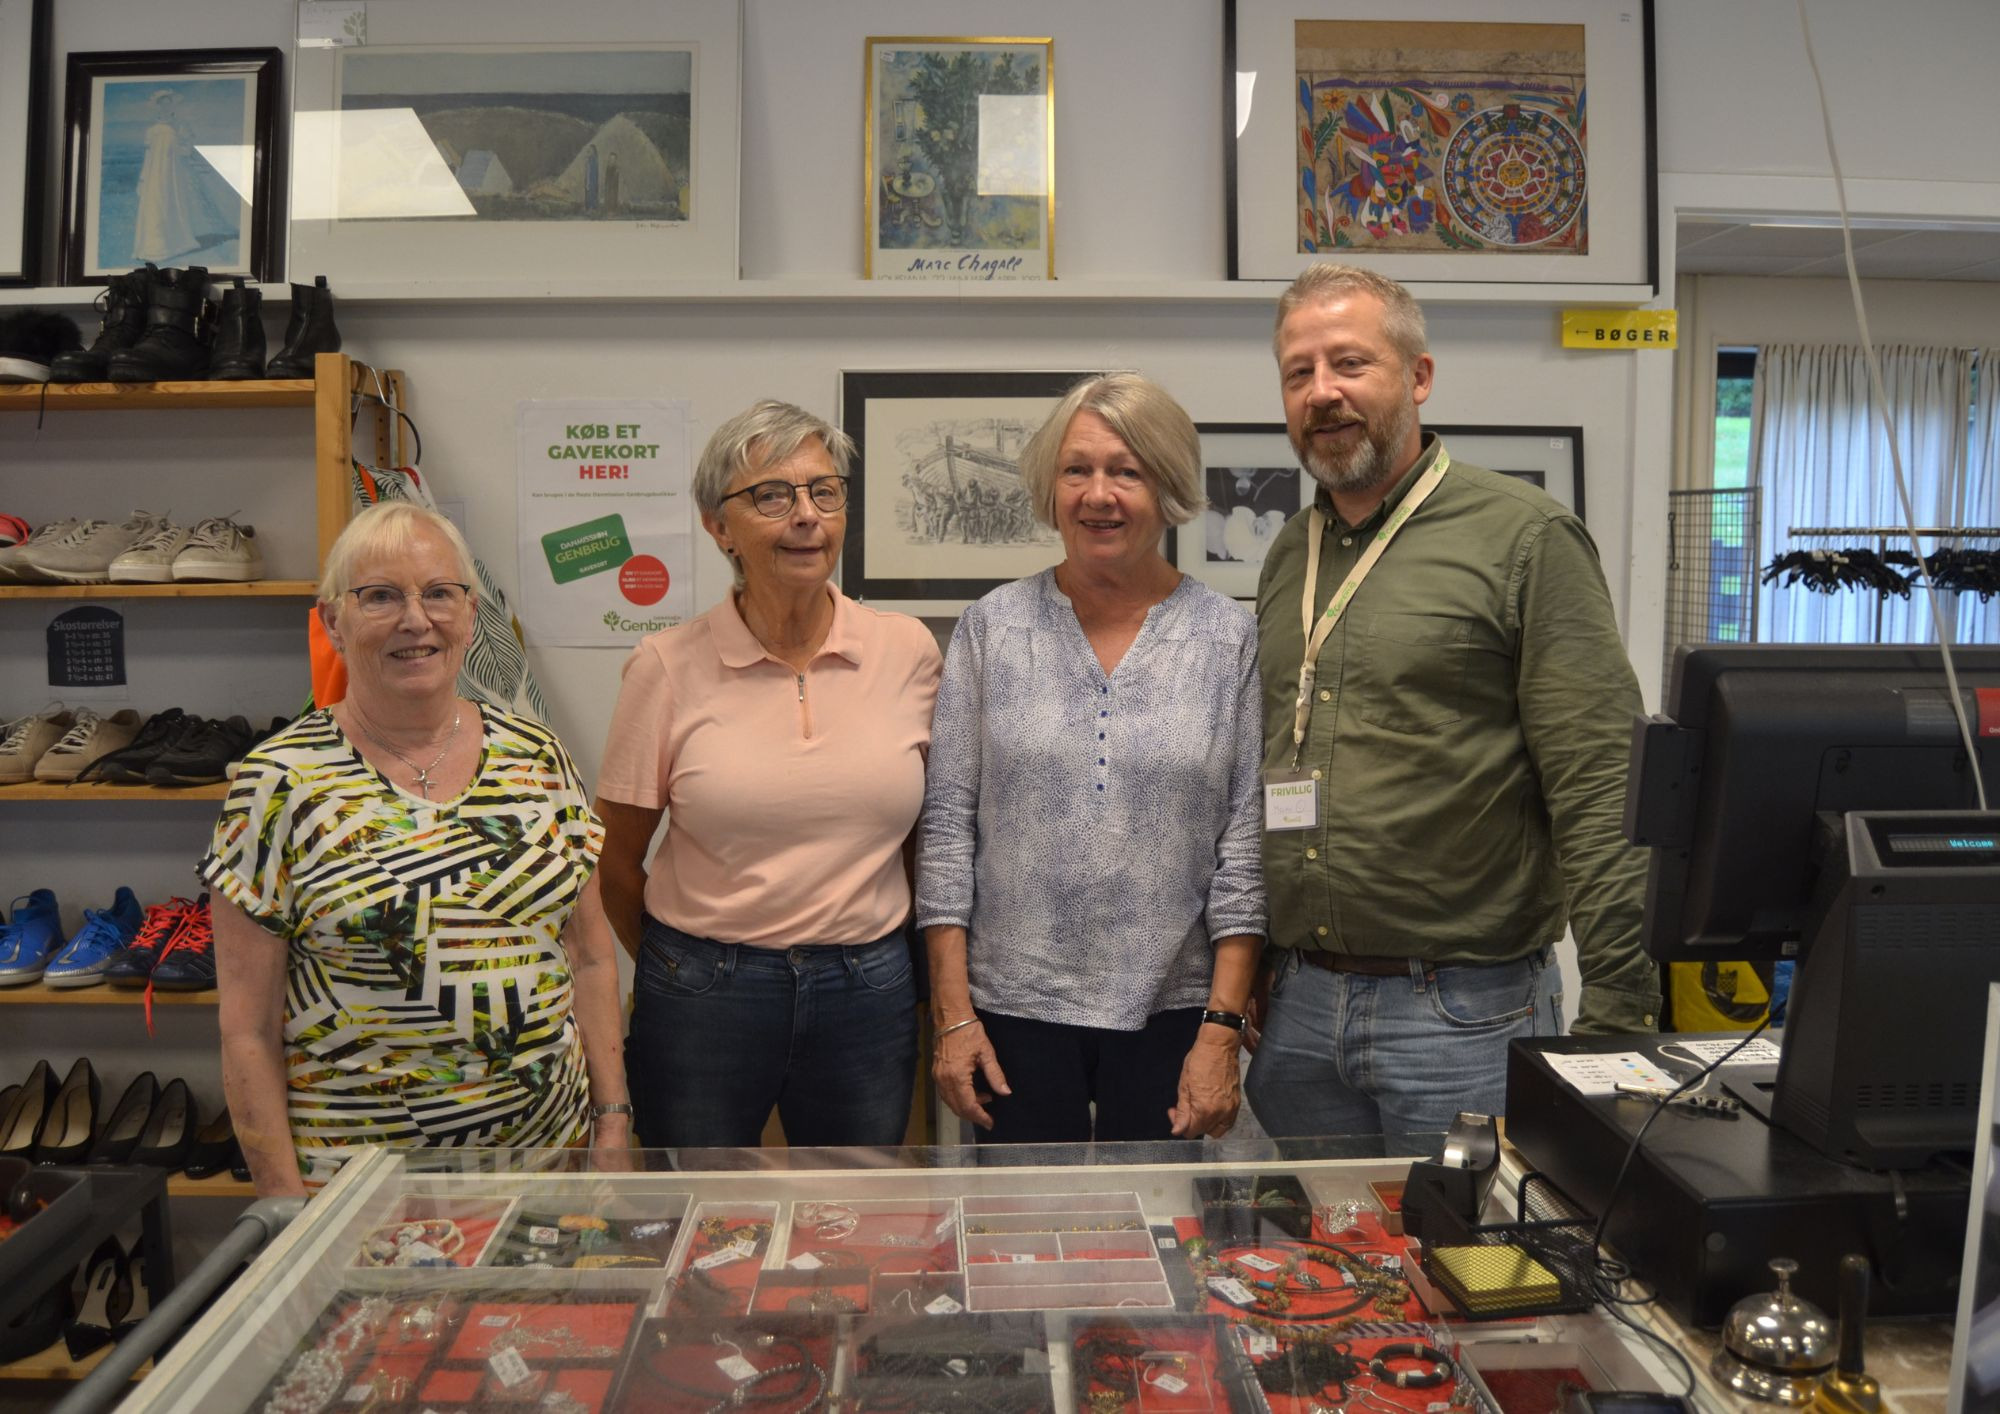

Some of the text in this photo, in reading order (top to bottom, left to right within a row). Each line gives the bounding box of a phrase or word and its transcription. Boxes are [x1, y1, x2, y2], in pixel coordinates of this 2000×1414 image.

[907, 253, 1023, 281] Marc Chagall
[1595, 328, 1669, 342] BØGER
[565, 424, 641, 440] KØB ET
[547, 444, 660, 460] GAVEKORT
[579, 465, 629, 480] HER!
[555, 535, 621, 564] GENBRUG
[620, 619, 679, 632] Genbru
[1271, 784, 1312, 797] FRIVILLIG
[1949, 839, 1994, 848] Welcome
